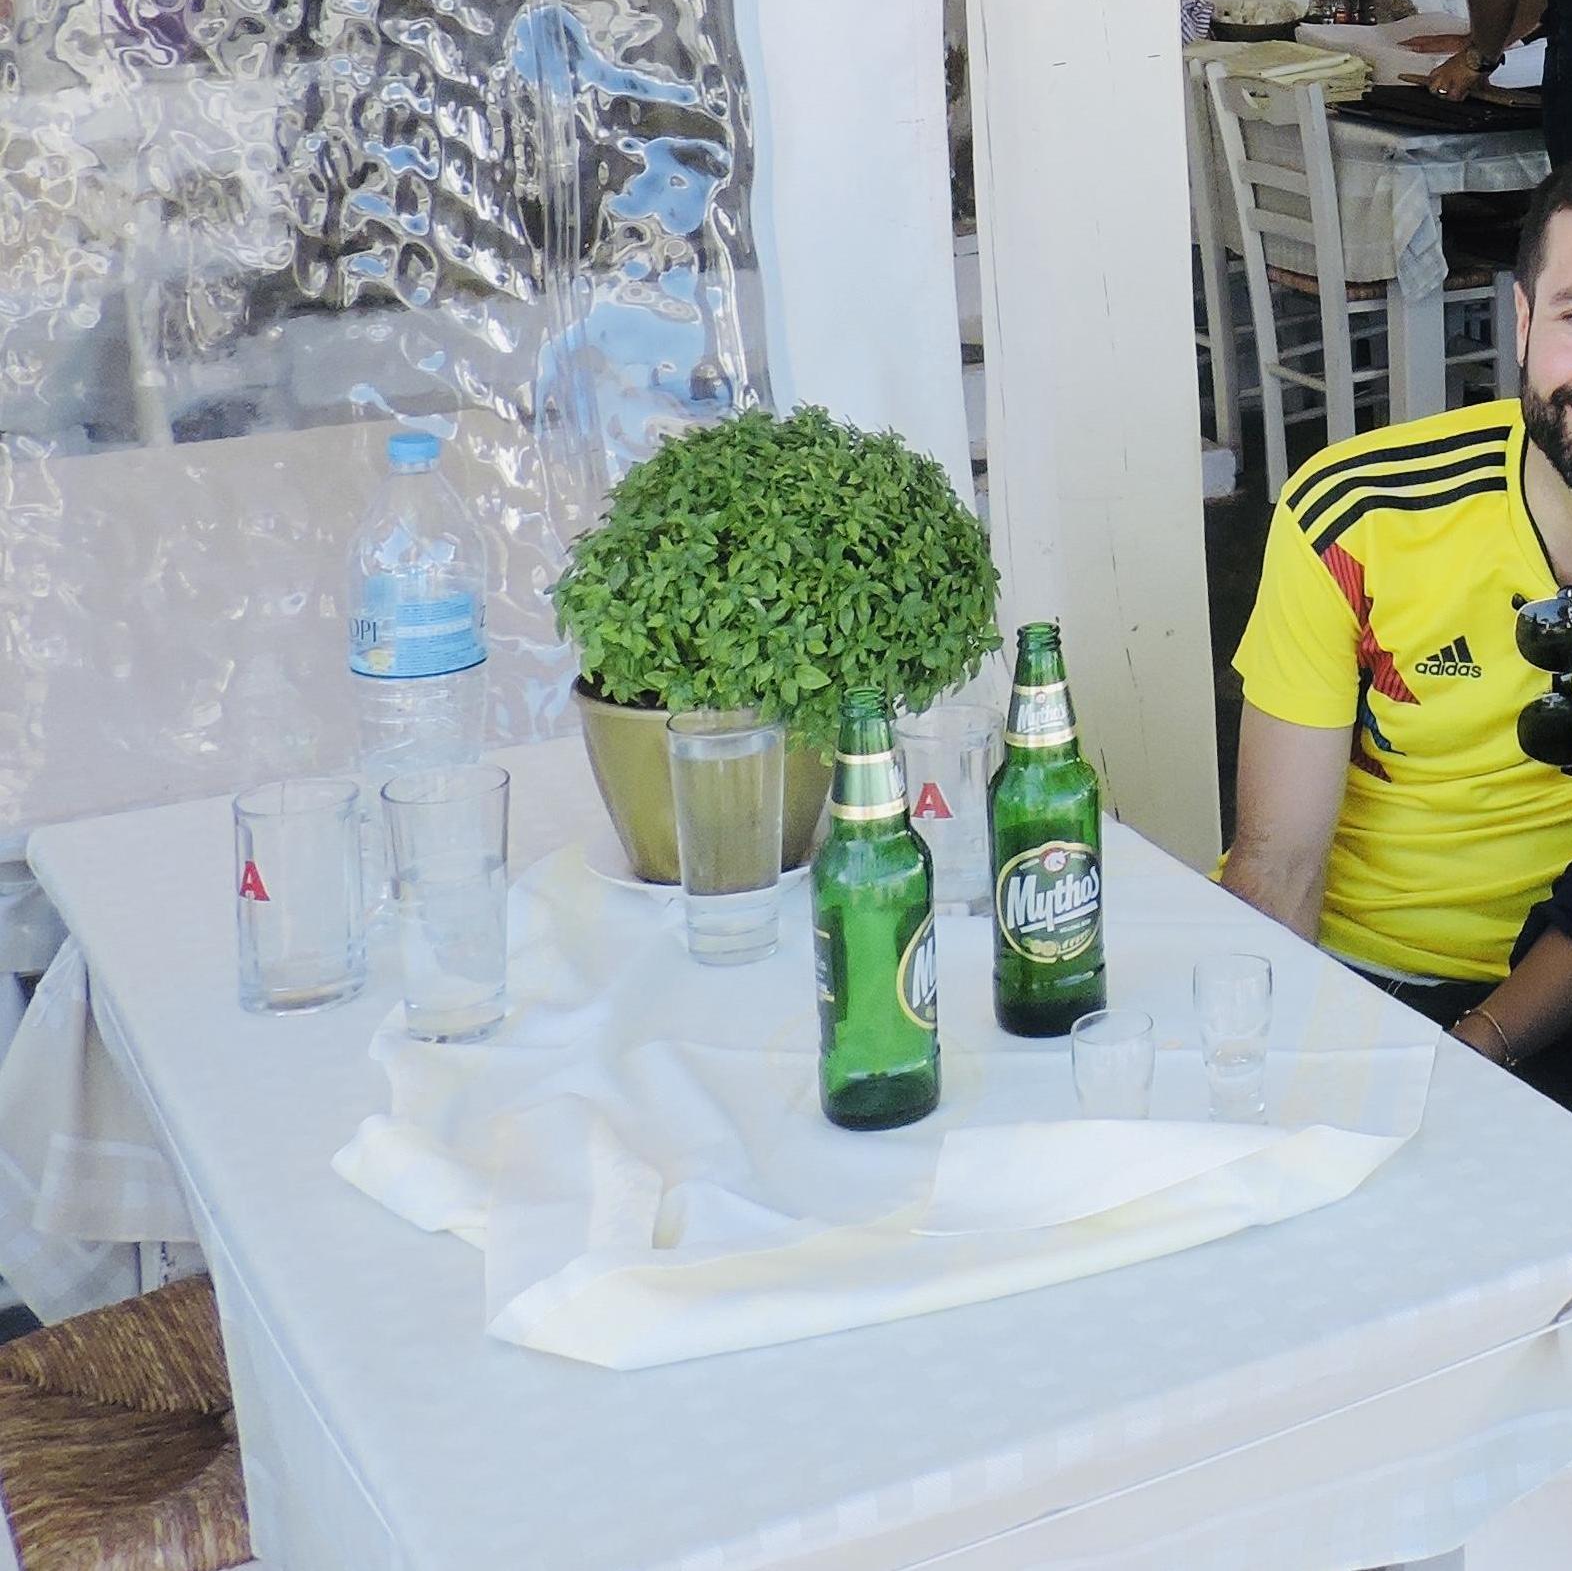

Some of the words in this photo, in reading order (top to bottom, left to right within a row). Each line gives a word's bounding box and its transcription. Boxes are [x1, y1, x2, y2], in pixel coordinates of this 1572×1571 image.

[1414, 659, 1483, 678] adidas
[1016, 701, 1068, 733] Mythos
[1006, 865, 1101, 932] Mythos
